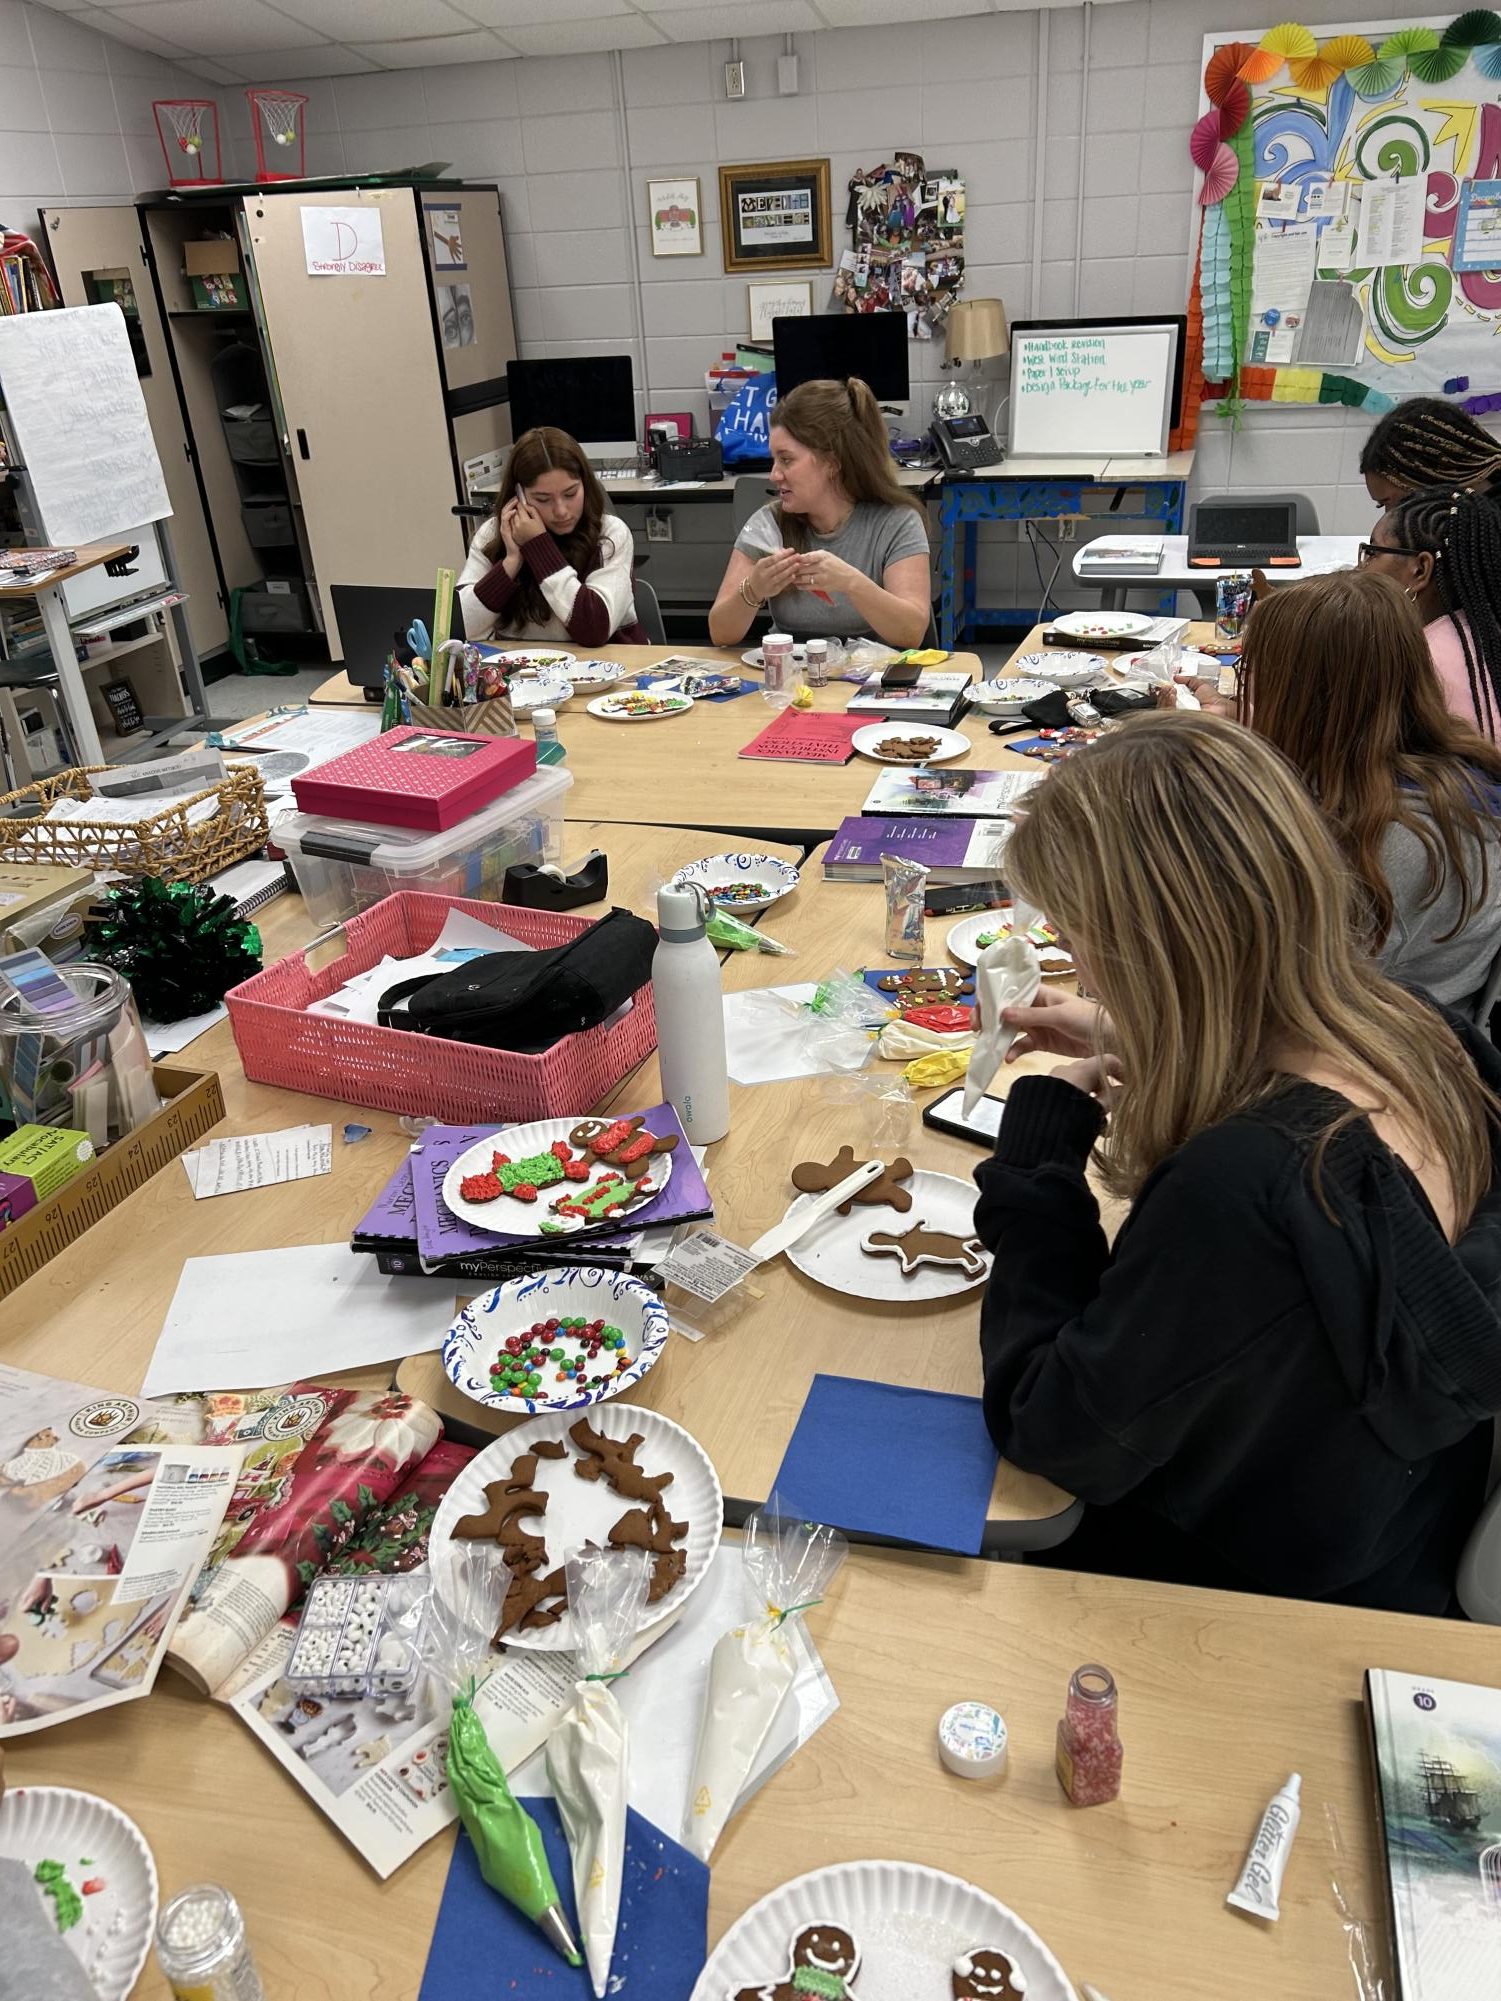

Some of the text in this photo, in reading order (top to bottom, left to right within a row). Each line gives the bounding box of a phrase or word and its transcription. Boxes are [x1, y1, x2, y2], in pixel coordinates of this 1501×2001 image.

[330, 222, 358, 261] D
[205, 1084, 217, 1097] 22
[683, 1095, 693, 1122] owala
[166, 1113, 179, 1128] 23
[3, 1129, 58, 1166] Vocabulary
[22, 1135, 65, 1165] SAT/ACT
[129, 1143, 141, 1159] 24
[86, 1178, 99, 1192] 25
[46, 1210, 58, 1223] 26
[3, 1242, 16, 1259] 27
[85, 1401, 112, 1413] KING
[1417, 1694, 1433, 1708] 10
[1254, 1803, 1290, 1861] Glitter
[1244, 1860, 1272, 1904] Gel
